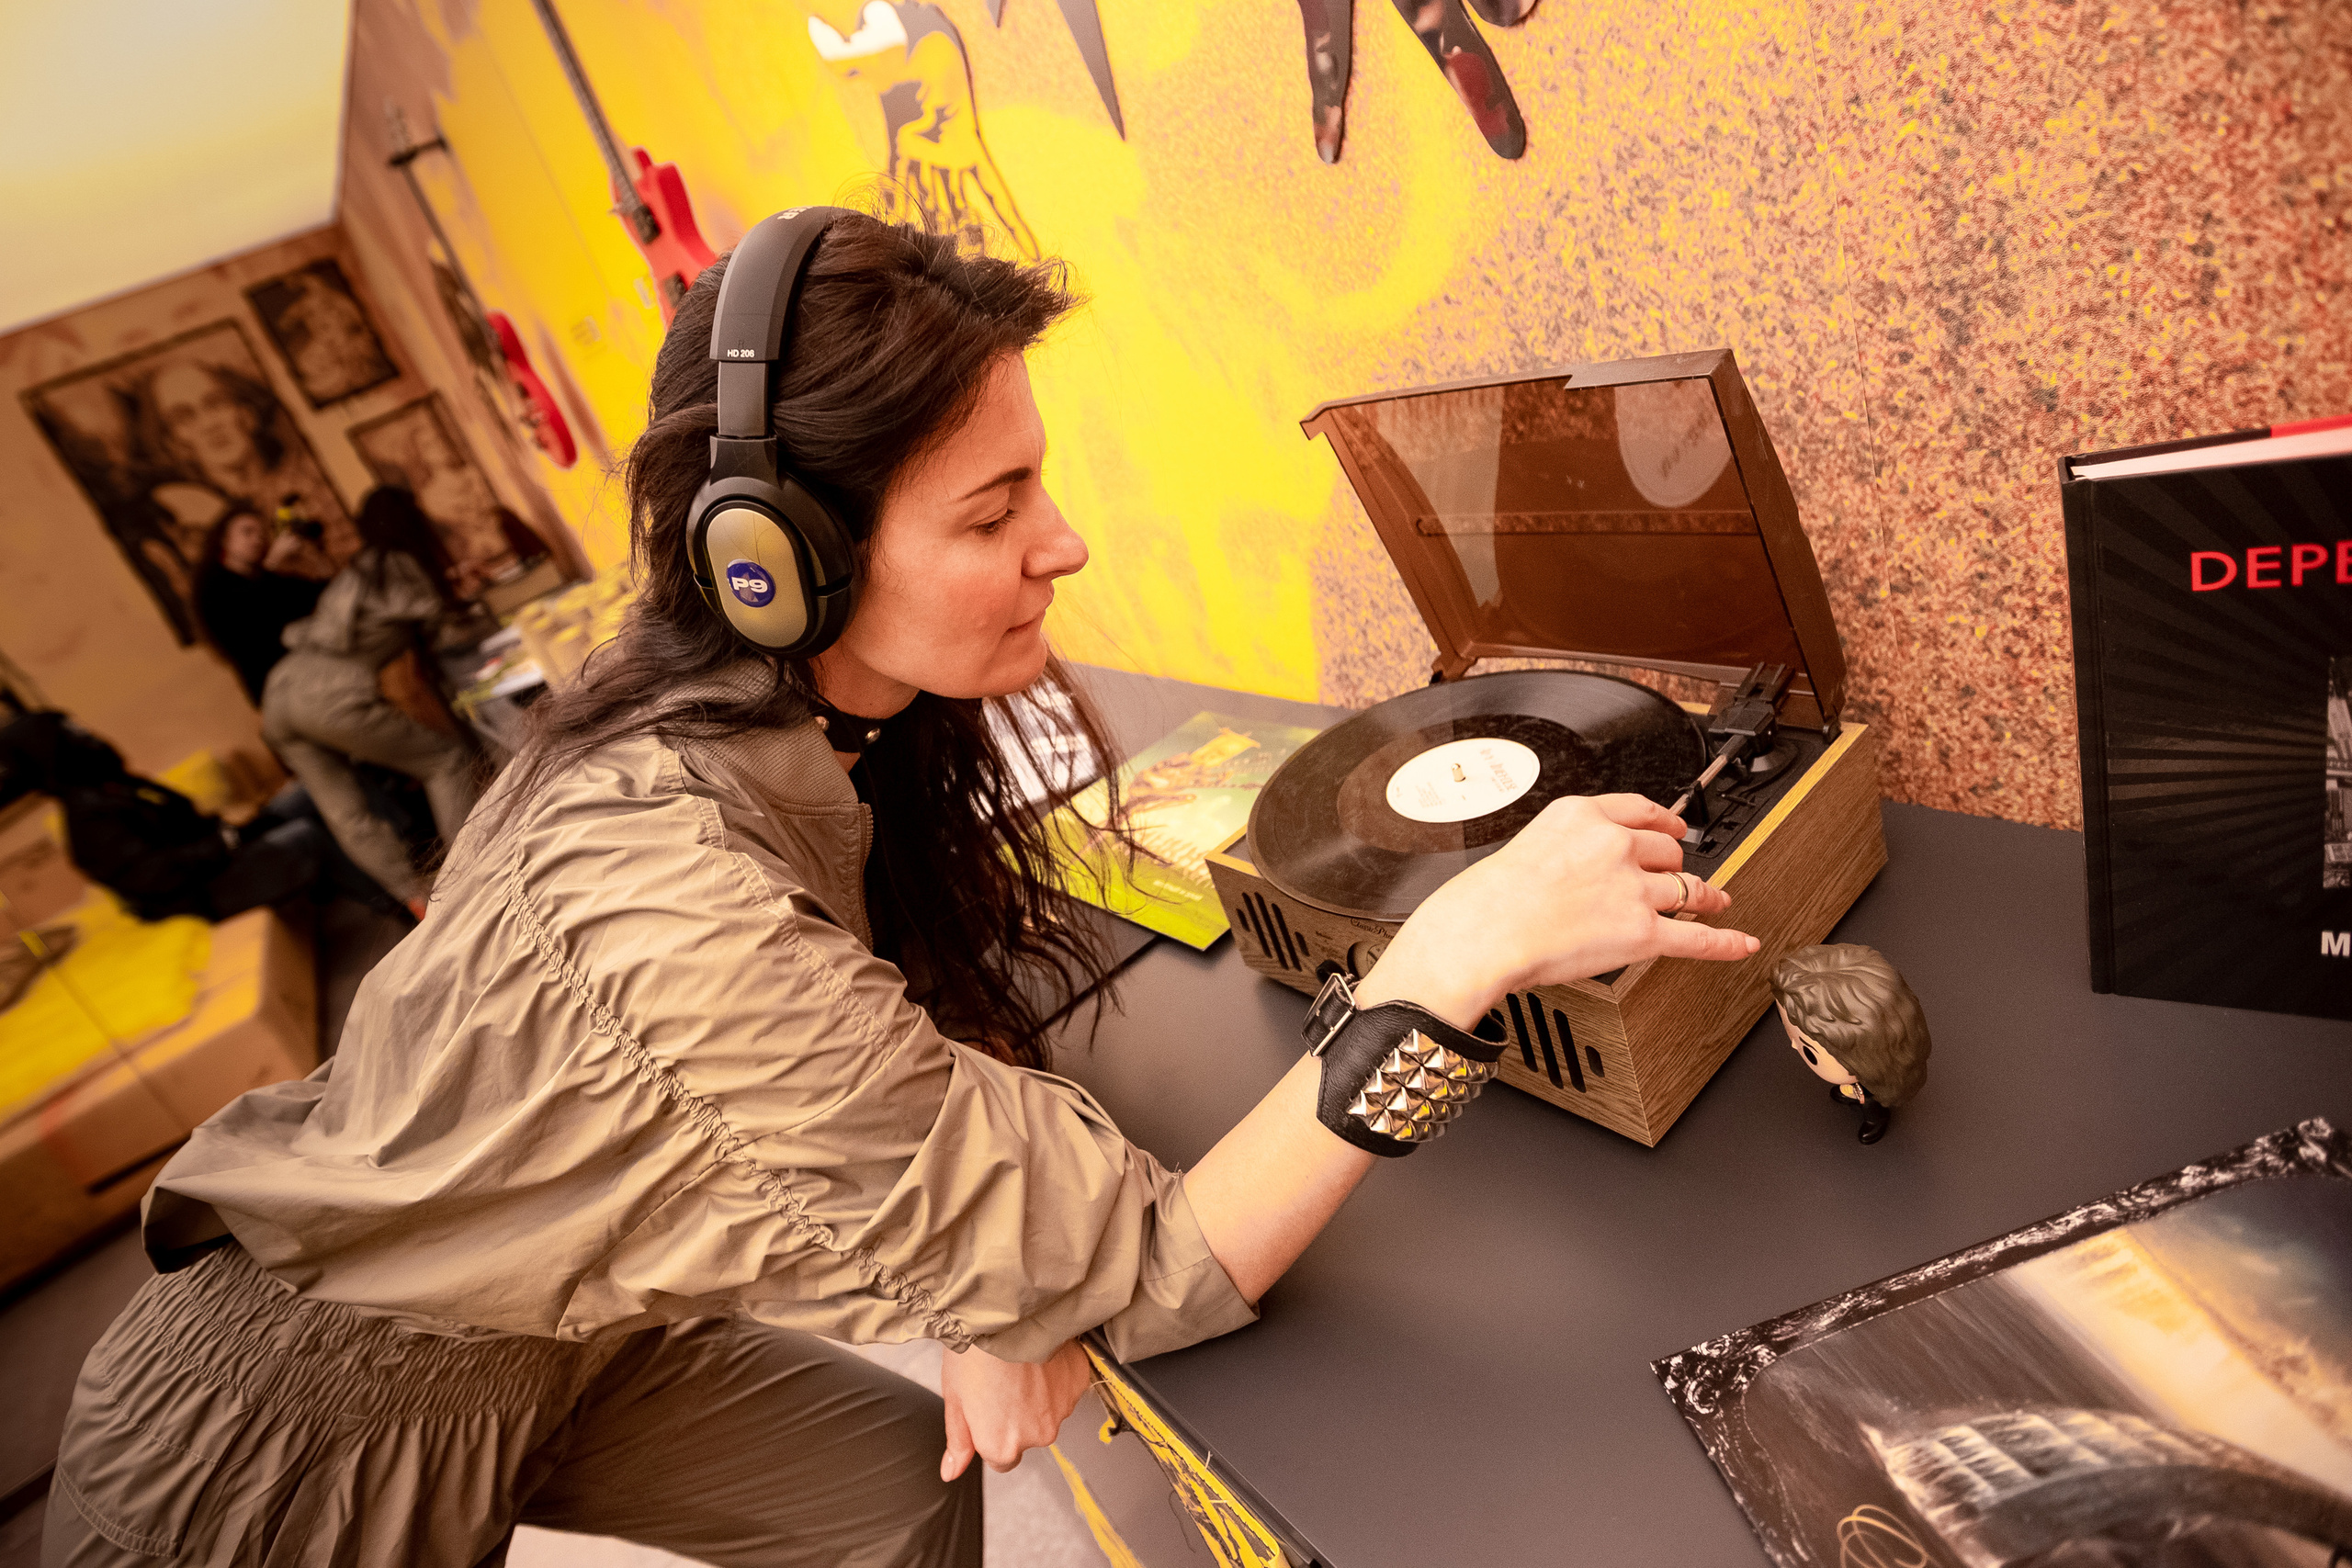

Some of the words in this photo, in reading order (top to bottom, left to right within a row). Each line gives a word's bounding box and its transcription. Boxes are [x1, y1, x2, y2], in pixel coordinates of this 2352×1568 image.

[727, 349, 740, 357] HD
[740, 349, 755, 358] 206
[731, 576, 768, 593] P9
[2321, 931, 2351, 957] M
